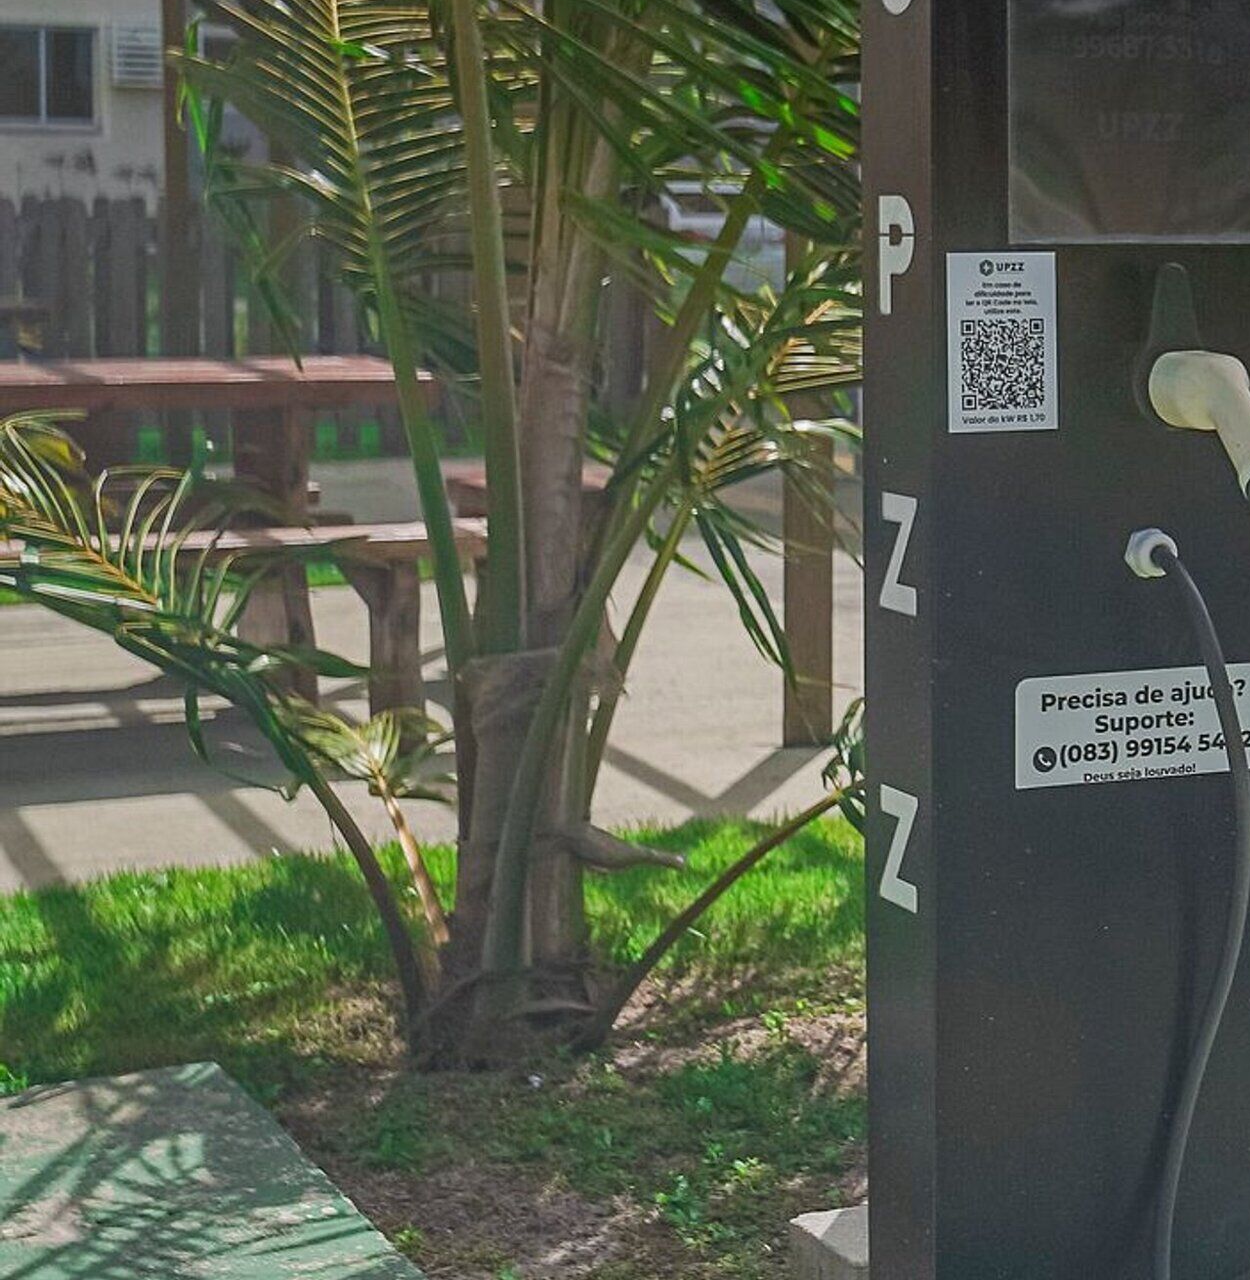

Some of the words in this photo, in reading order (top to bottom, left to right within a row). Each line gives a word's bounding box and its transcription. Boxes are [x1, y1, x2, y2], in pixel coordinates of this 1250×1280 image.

[995, 262, 1024, 272] UPZZ
[961, 415, 986, 425] Valor
[1041, 687, 1128, 713] Precisa
[1135, 684, 1165, 705] de
[1171, 679, 1246, 706] aju?
[1094, 710, 1195, 736] Suporte:
[1060, 740, 1119, 769] (083)
[1125, 736, 1192, 759] 99154
[1083, 773, 1115, 783] Deus
[1118, 768, 1142, 780] seja
[1145, 763, 1196, 777] louvado!
